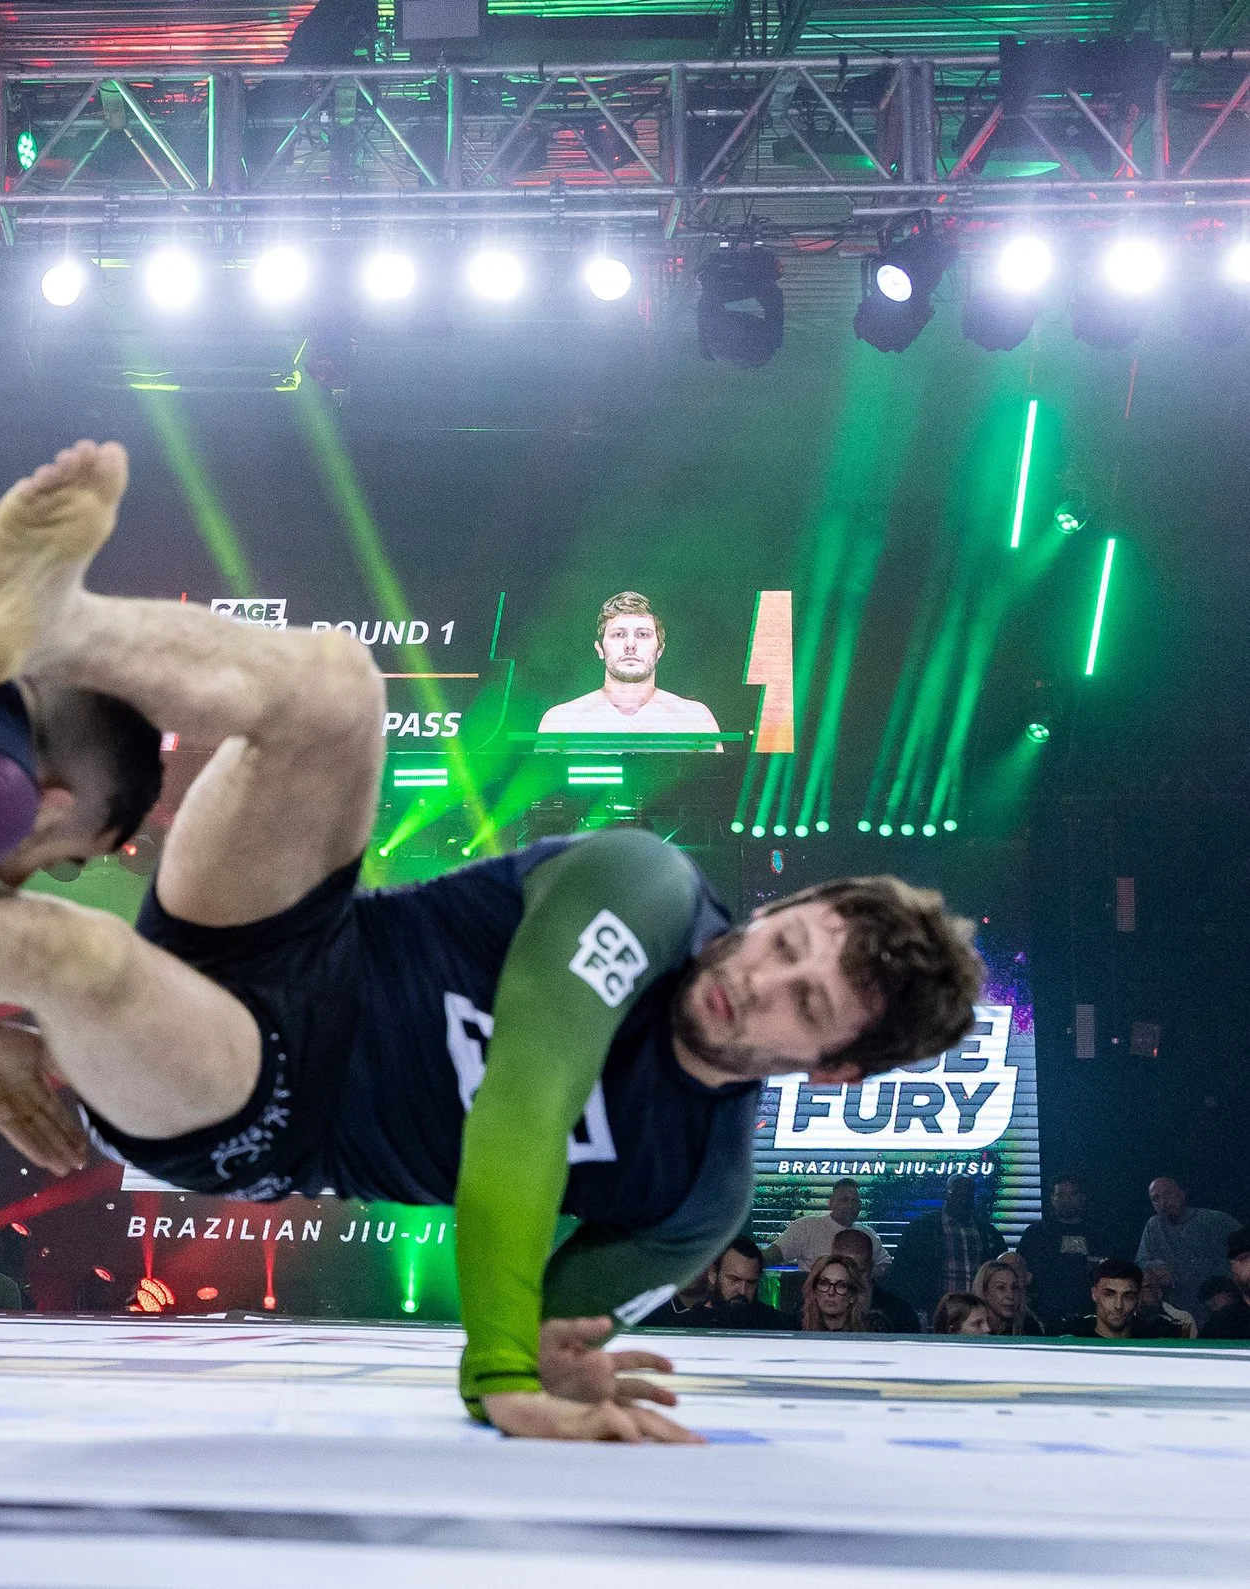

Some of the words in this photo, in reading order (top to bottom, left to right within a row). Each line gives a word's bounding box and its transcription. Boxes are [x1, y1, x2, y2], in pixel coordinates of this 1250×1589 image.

[440, 620, 456, 645] 1
[381, 712, 462, 738] PASS
[791, 1081, 1001, 1134] FURY
[778, 1161, 886, 1175] BRAZILIAN
[894, 1161, 994, 1176] JIU-JITSU
[127, 1216, 323, 1242] BRAZILIAN
[339, 1220, 457, 1245] JIU-JI
